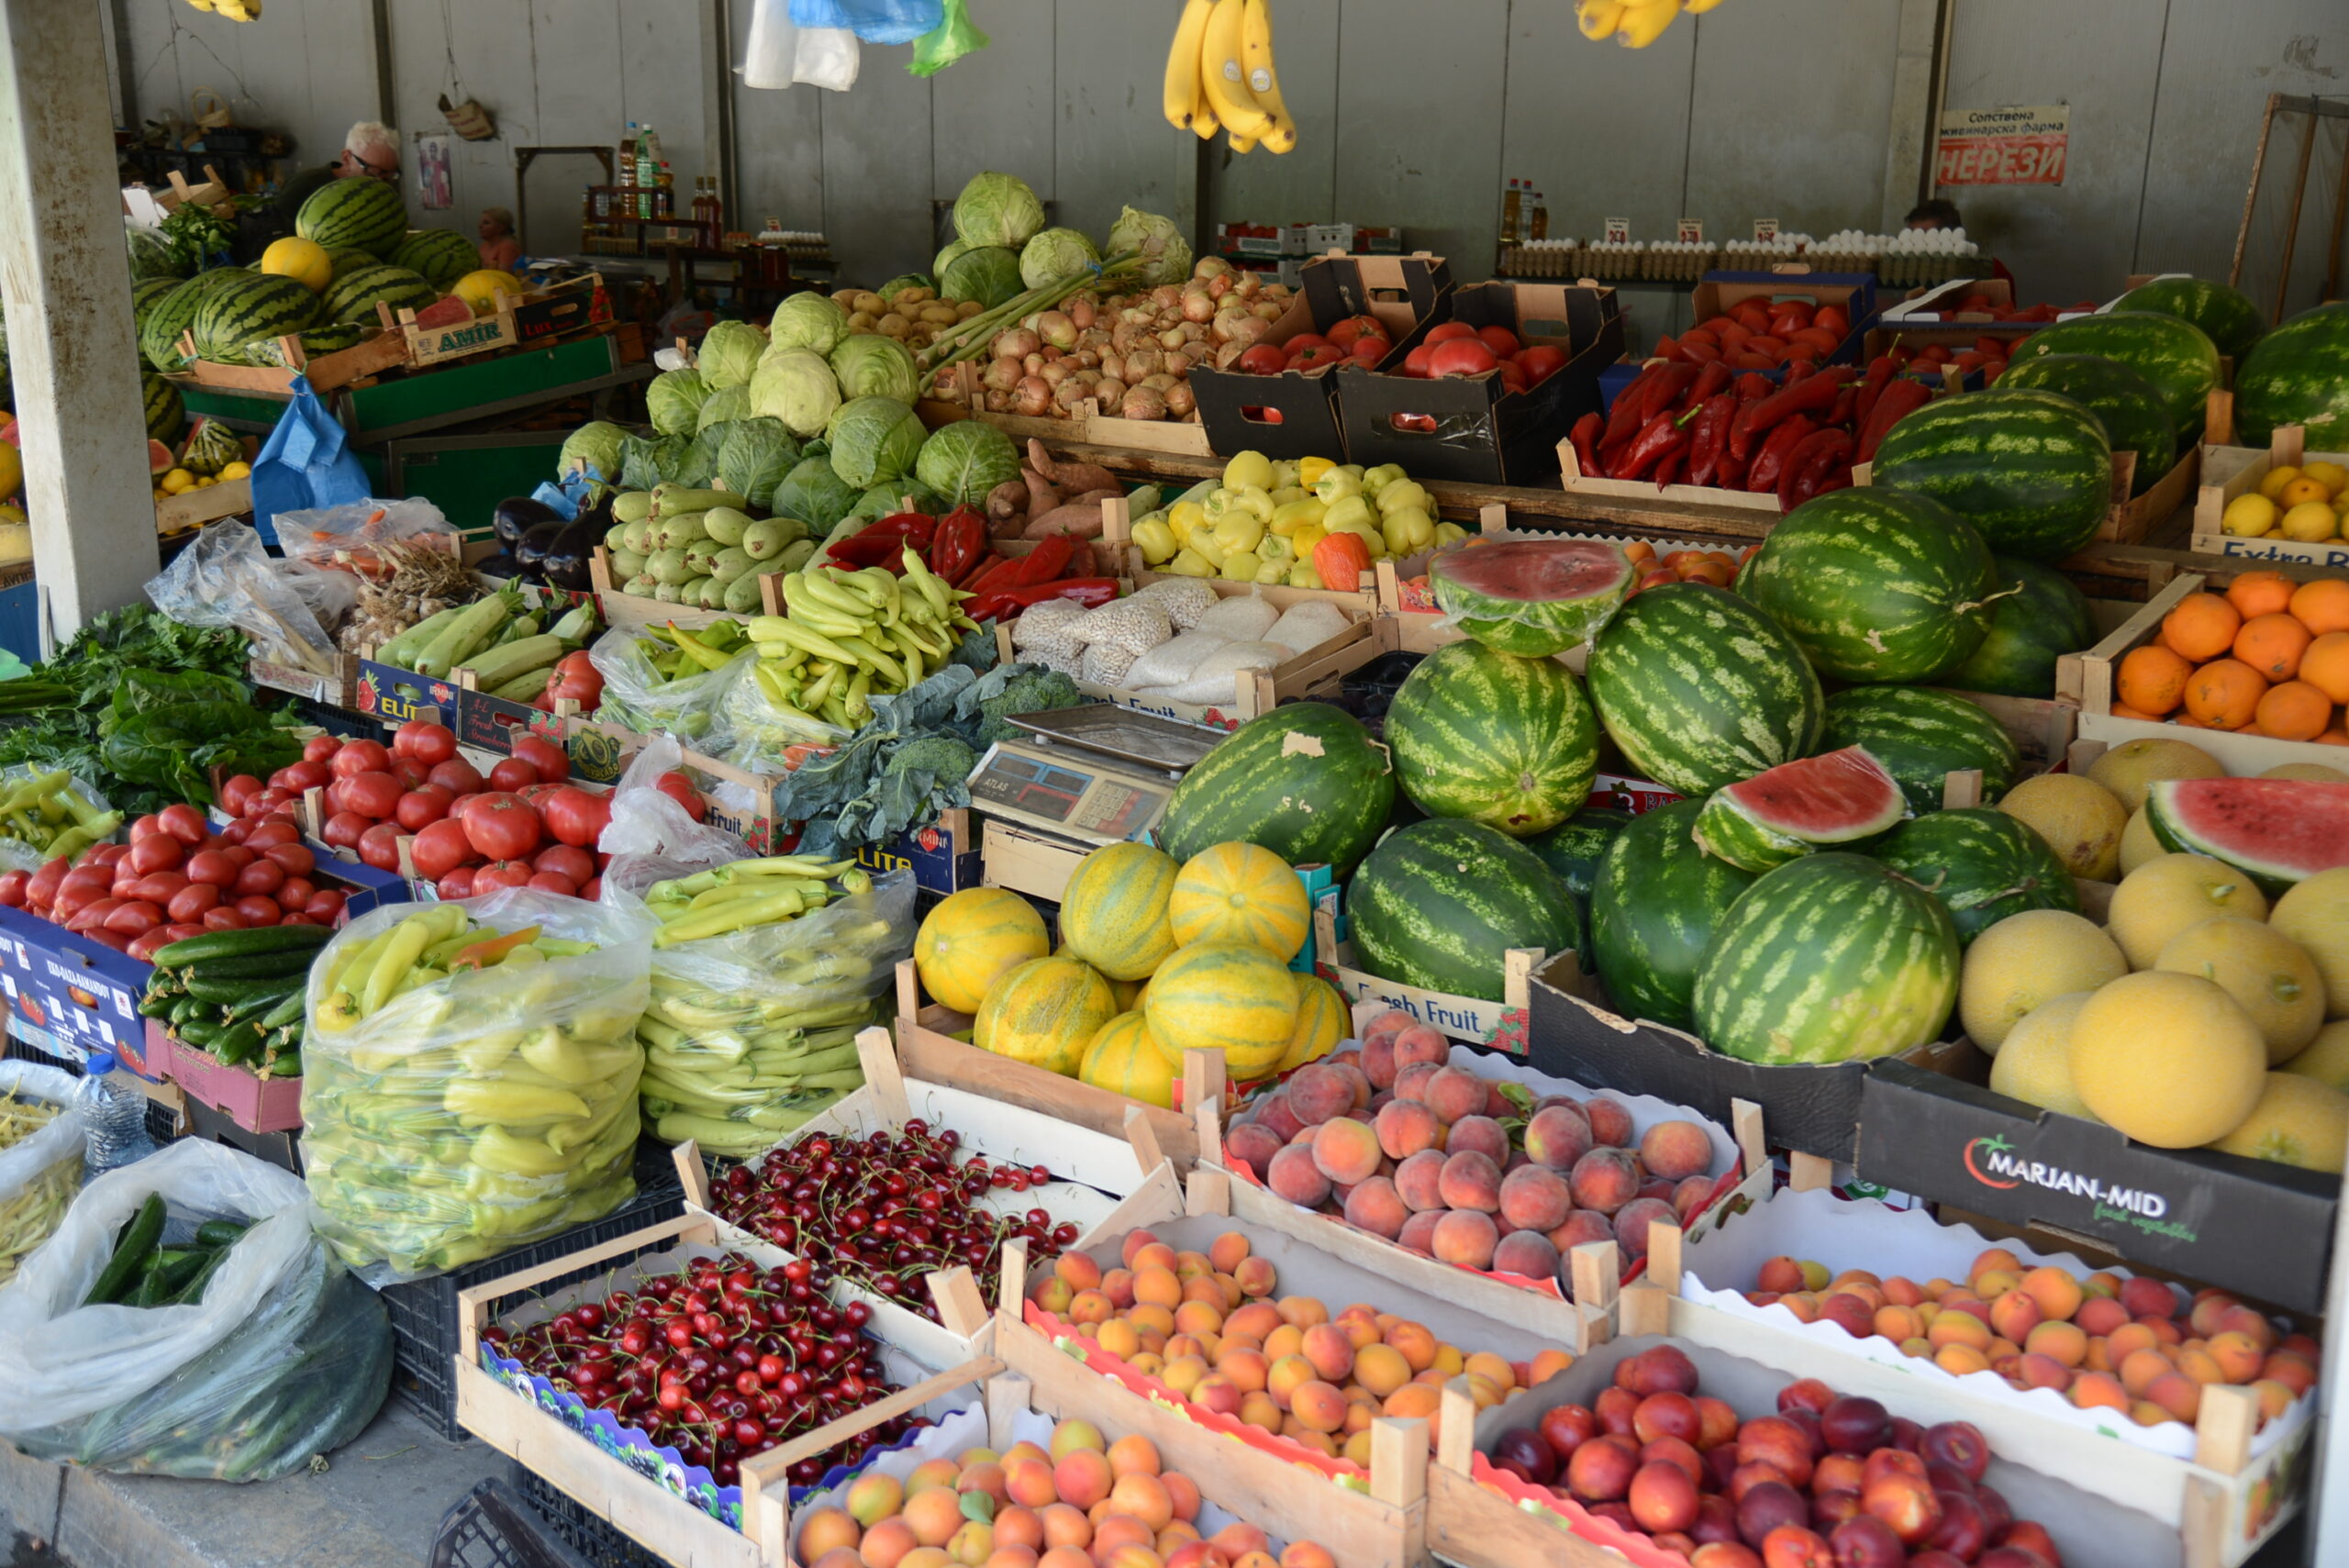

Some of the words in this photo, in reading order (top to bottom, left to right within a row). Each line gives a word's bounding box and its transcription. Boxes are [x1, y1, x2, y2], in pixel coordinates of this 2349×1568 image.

[1968, 112, 2035, 125] Сопствена
[2021, 121, 2064, 136] фарма
[1938, 146, 2064, 180] НЕРЕЗИ
[381, 696, 418, 721] ELIT
[984, 777, 1009, 792] ATLAS
[709, 806, 742, 837] Fruit
[1358, 983, 1419, 1018] esh
[1425, 999, 1481, 1034] Fruit
[1987, 1151, 2167, 1218] MARJAN-MID
